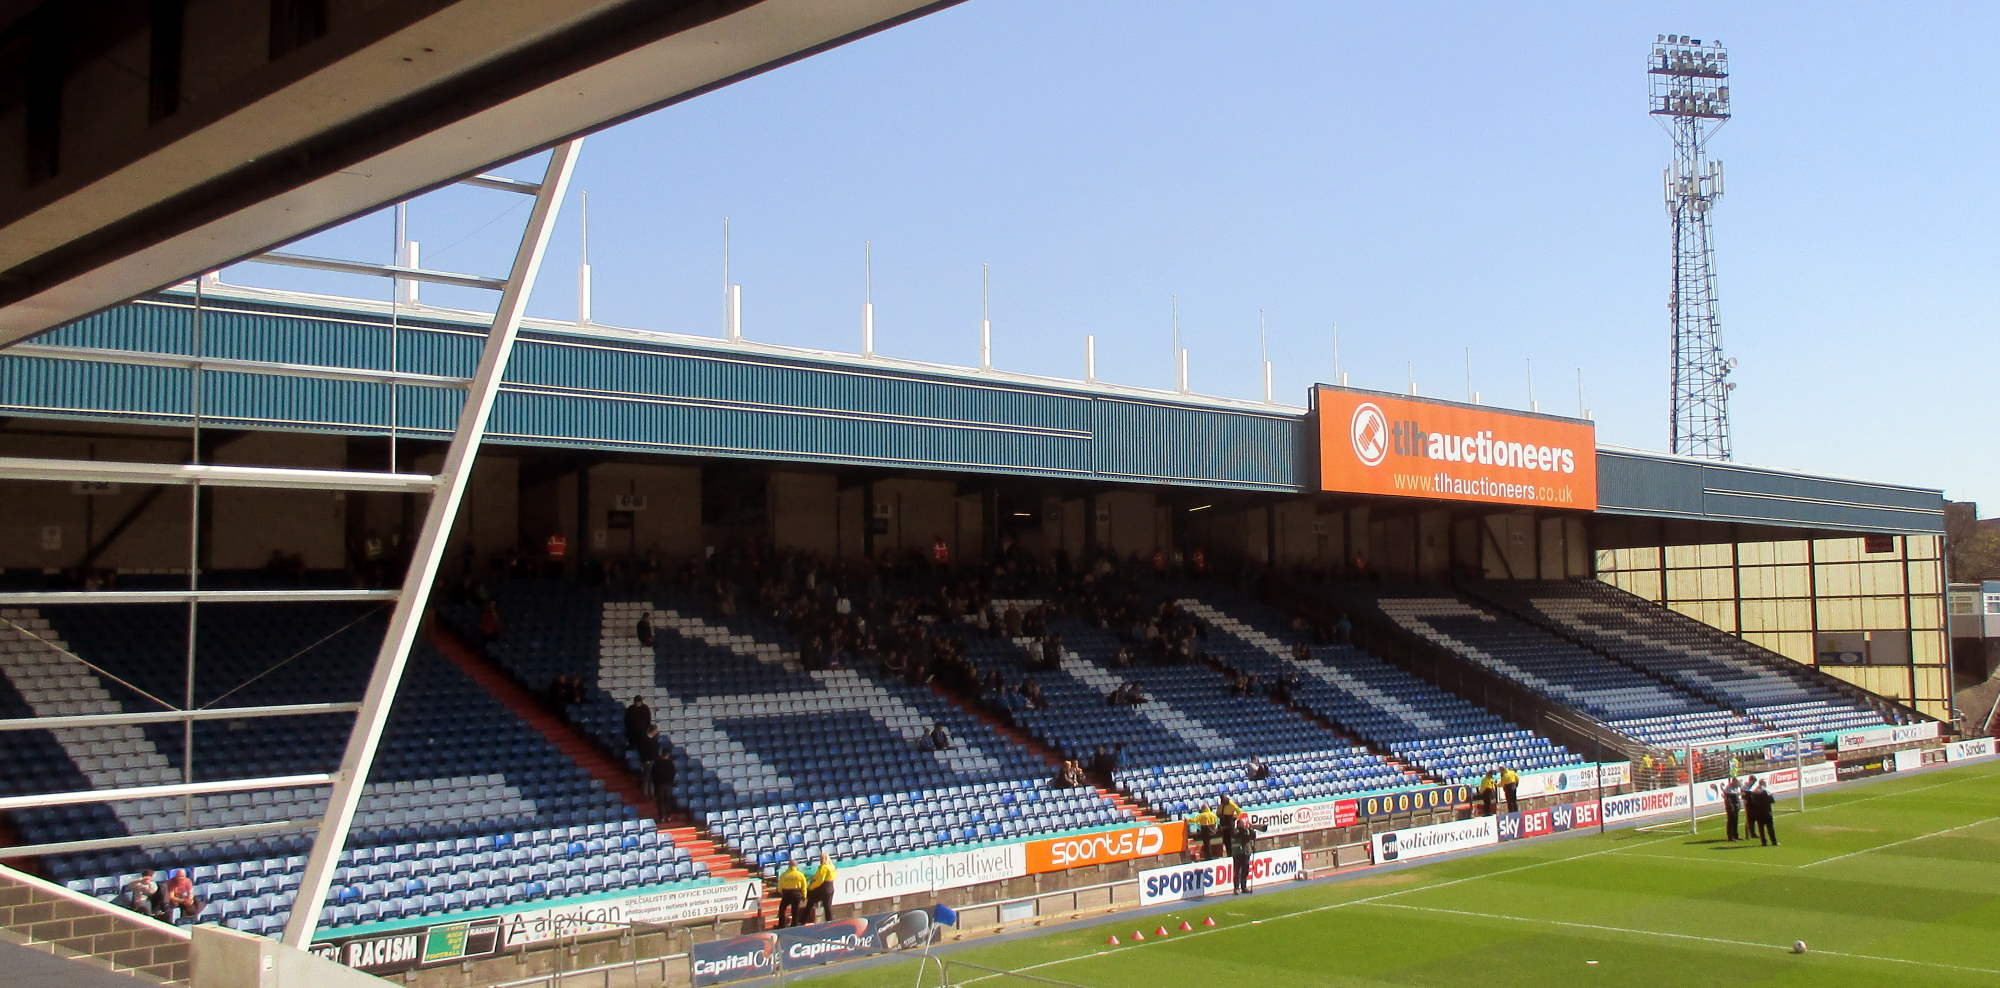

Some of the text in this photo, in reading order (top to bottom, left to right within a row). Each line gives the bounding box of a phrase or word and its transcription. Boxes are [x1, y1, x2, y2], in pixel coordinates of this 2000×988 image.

[1392, 420, 1575, 474] tlhauctioneers
[1393, 472, 1573, 504] www.tlhauctioneers.co.uk
[1251, 810, 1294, 827] Premier
[1605, 793, 1687, 818] SPORTSDIRECT.COM
[1399, 821, 1490, 851] solicitors.co.uk
[1499, 803, 1599, 841] sky BET sky BET
[1051, 832, 1133, 865] sports
[843, 846, 1014, 894] northainleyhalliwell
[1146, 857, 1297, 898] SPORTSDIECT.COM
[625, 893, 668, 906] SPECIALISTS
[678, 889, 701, 899] OFFICE
[702, 884, 739, 896] SOLUTIONS
[534, 905, 621, 934] alexican
[682, 908, 702, 919] 0161
[349, 935, 418, 968] RACISM
